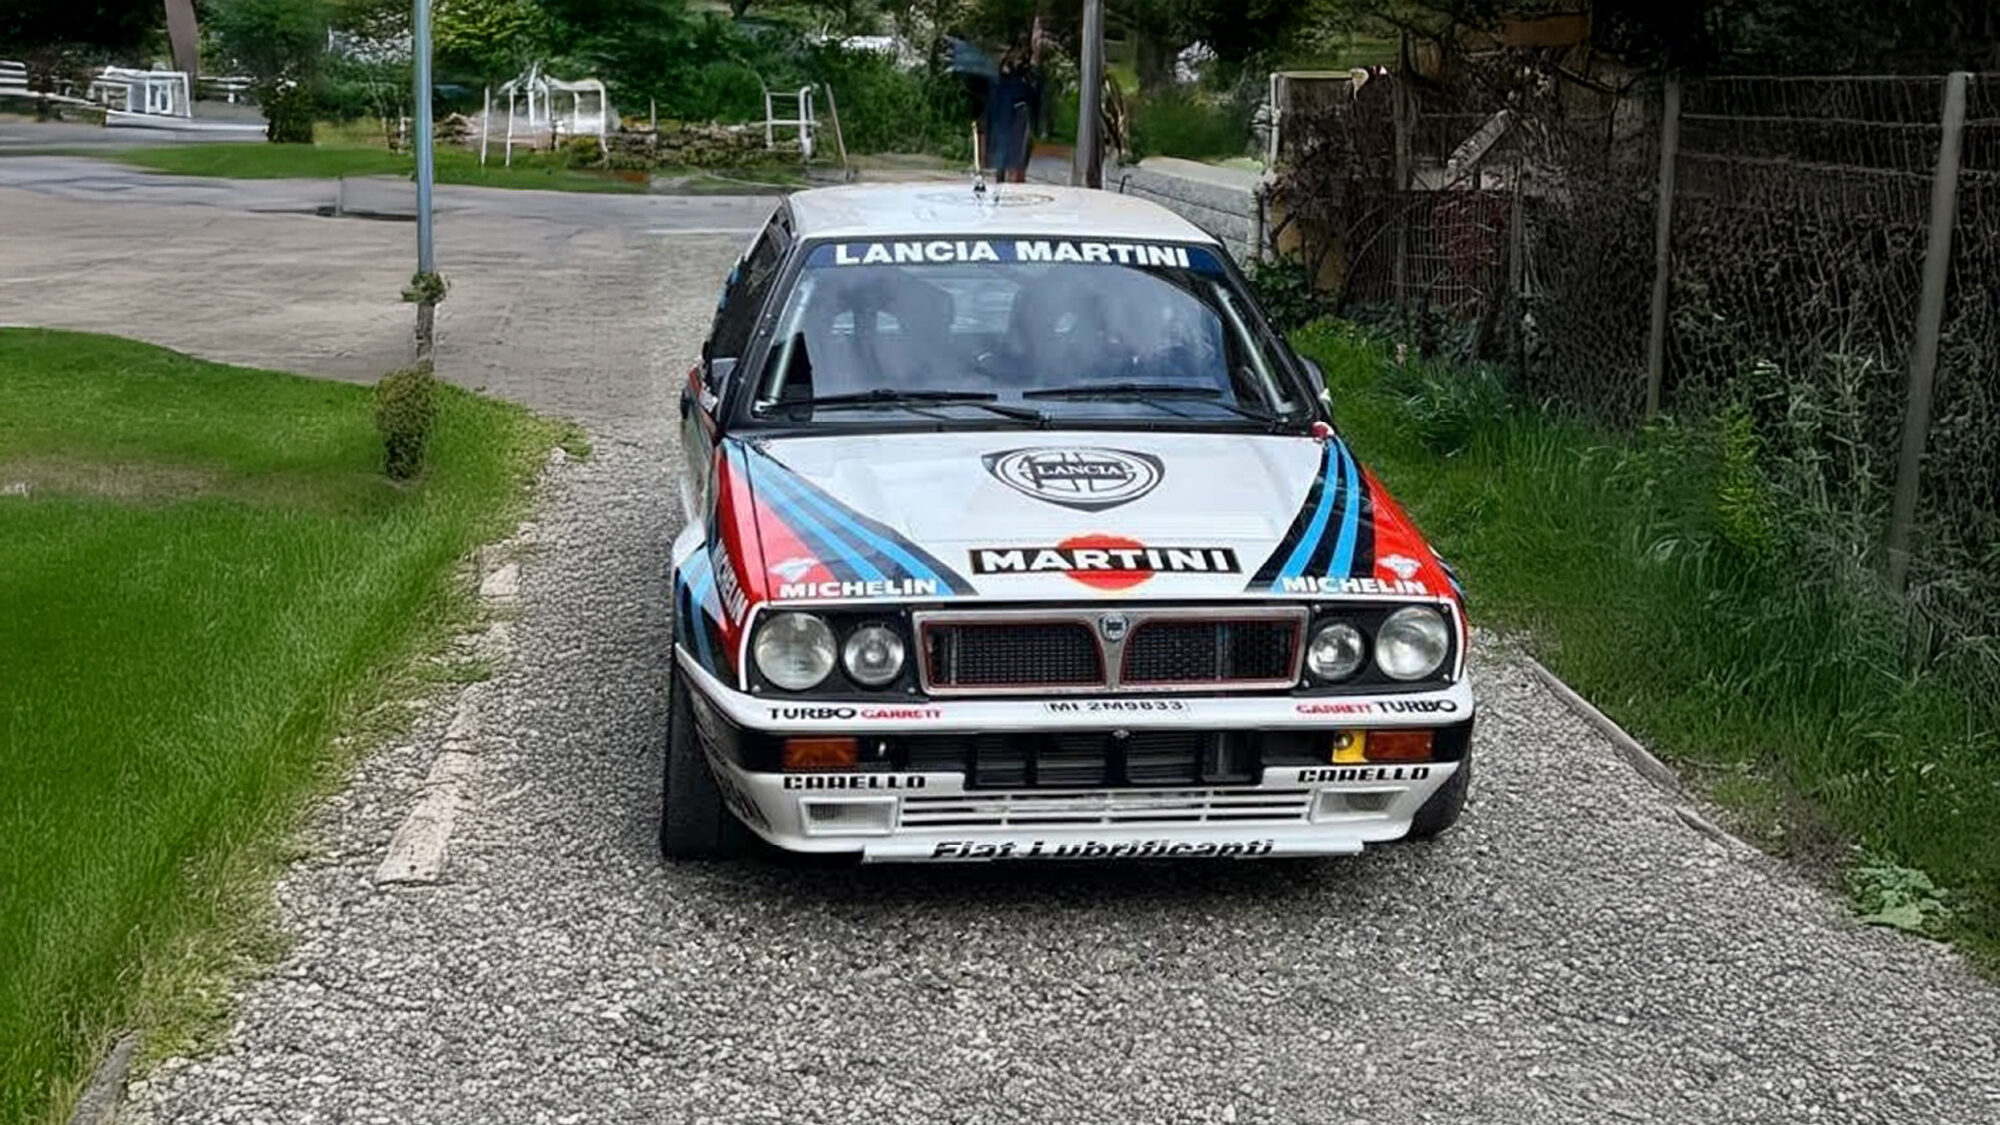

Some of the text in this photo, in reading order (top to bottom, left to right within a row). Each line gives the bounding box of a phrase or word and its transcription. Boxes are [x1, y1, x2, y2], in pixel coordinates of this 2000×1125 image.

[836, 241, 1190, 268] LANCIA MARTINI
[1035, 464, 1123, 476] LANCIA
[981, 550, 1229, 572] MARTINI
[779, 579, 939, 598] MICHELIN
[1281, 577, 1429, 595] MICHELIN
[767, 707, 942, 720] TURBO GARRETT
[1296, 700, 1458, 714] GARRETT TURBO
[783, 776, 926, 790] CARELLO
[1298, 767, 1430, 783] CARELLO
[929, 839, 1275, 859] Fiat Lubrificanti
